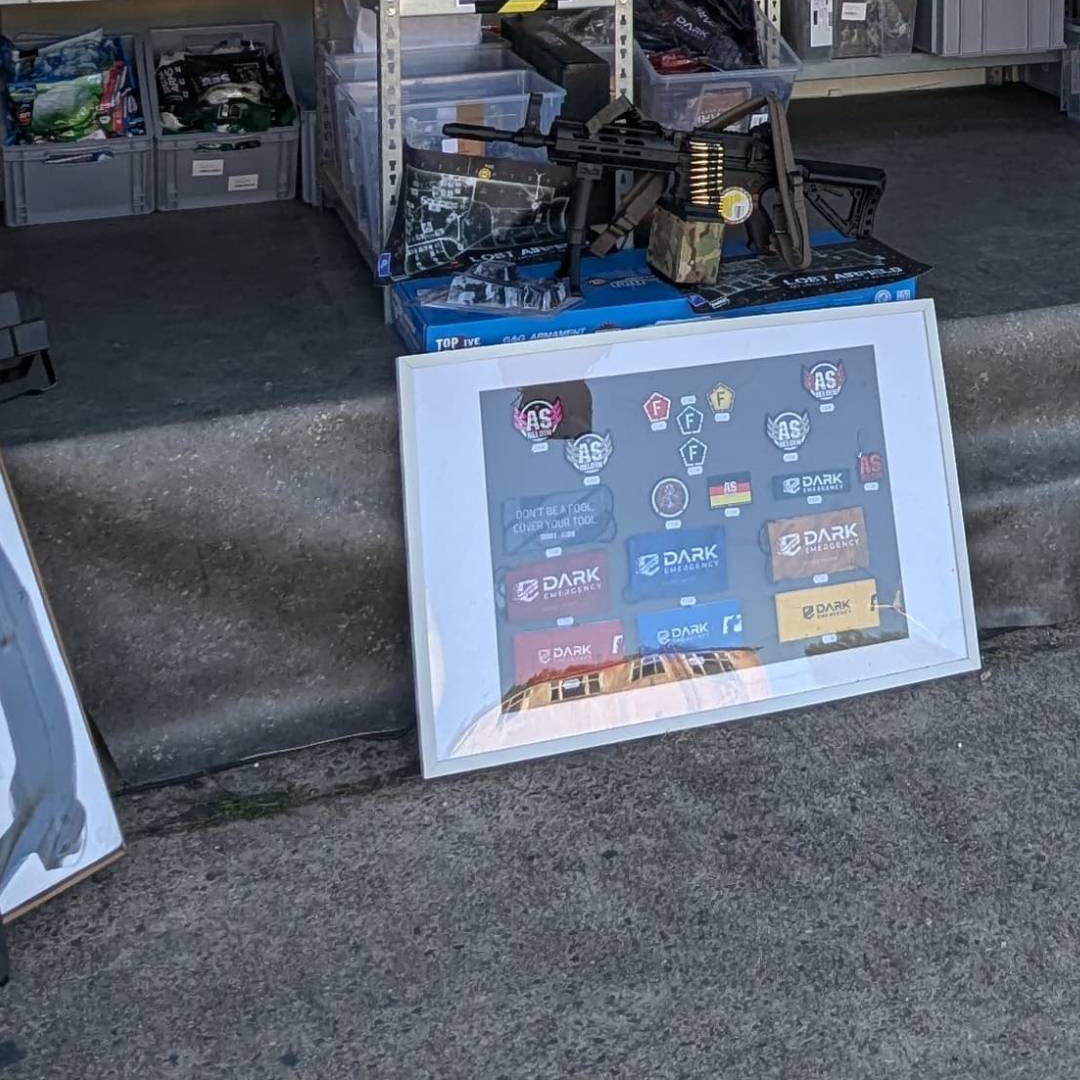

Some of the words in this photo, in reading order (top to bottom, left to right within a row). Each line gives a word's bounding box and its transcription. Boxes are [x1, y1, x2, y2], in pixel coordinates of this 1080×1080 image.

[783, 274, 829, 287] LOST
[834, 266, 903, 281] AIRFIELD
[814, 369, 838, 392] AS
[716, 391, 726, 407] F
[651, 400, 662, 417] F
[527, 407, 553, 432] AS
[685, 413, 695, 430] F
[778, 419, 801, 441] AS
[578, 441, 603, 464] AS
[688, 445, 698, 461] F
[860, 453, 882, 475] AS
[723, 481, 738, 493] AS
[802, 473, 843, 488] DARK
[803, 483, 843, 494] EMERGENCY
[516, 506, 545, 521] DON'T
[546, 504, 559, 516] BE
[560, 504, 567, 514] A
[568, 501, 595, 515] FOOL
[513, 520, 545, 534] COVER
[546, 517, 570, 529] YOUR
[573, 515, 597, 526] TOOL
[804, 522, 858, 547] DARK
[663, 544, 718, 567] DARK
[805, 538, 860, 555] EMERGENCY
[663, 560, 720, 575] EMERGENCY
[543, 566, 601, 592] DARK
[543, 583, 602, 601] EMERGENCY
[816, 599, 851, 614] DARK
[671, 621, 710, 639] DARK
[553, 644, 593, 659] DARK
